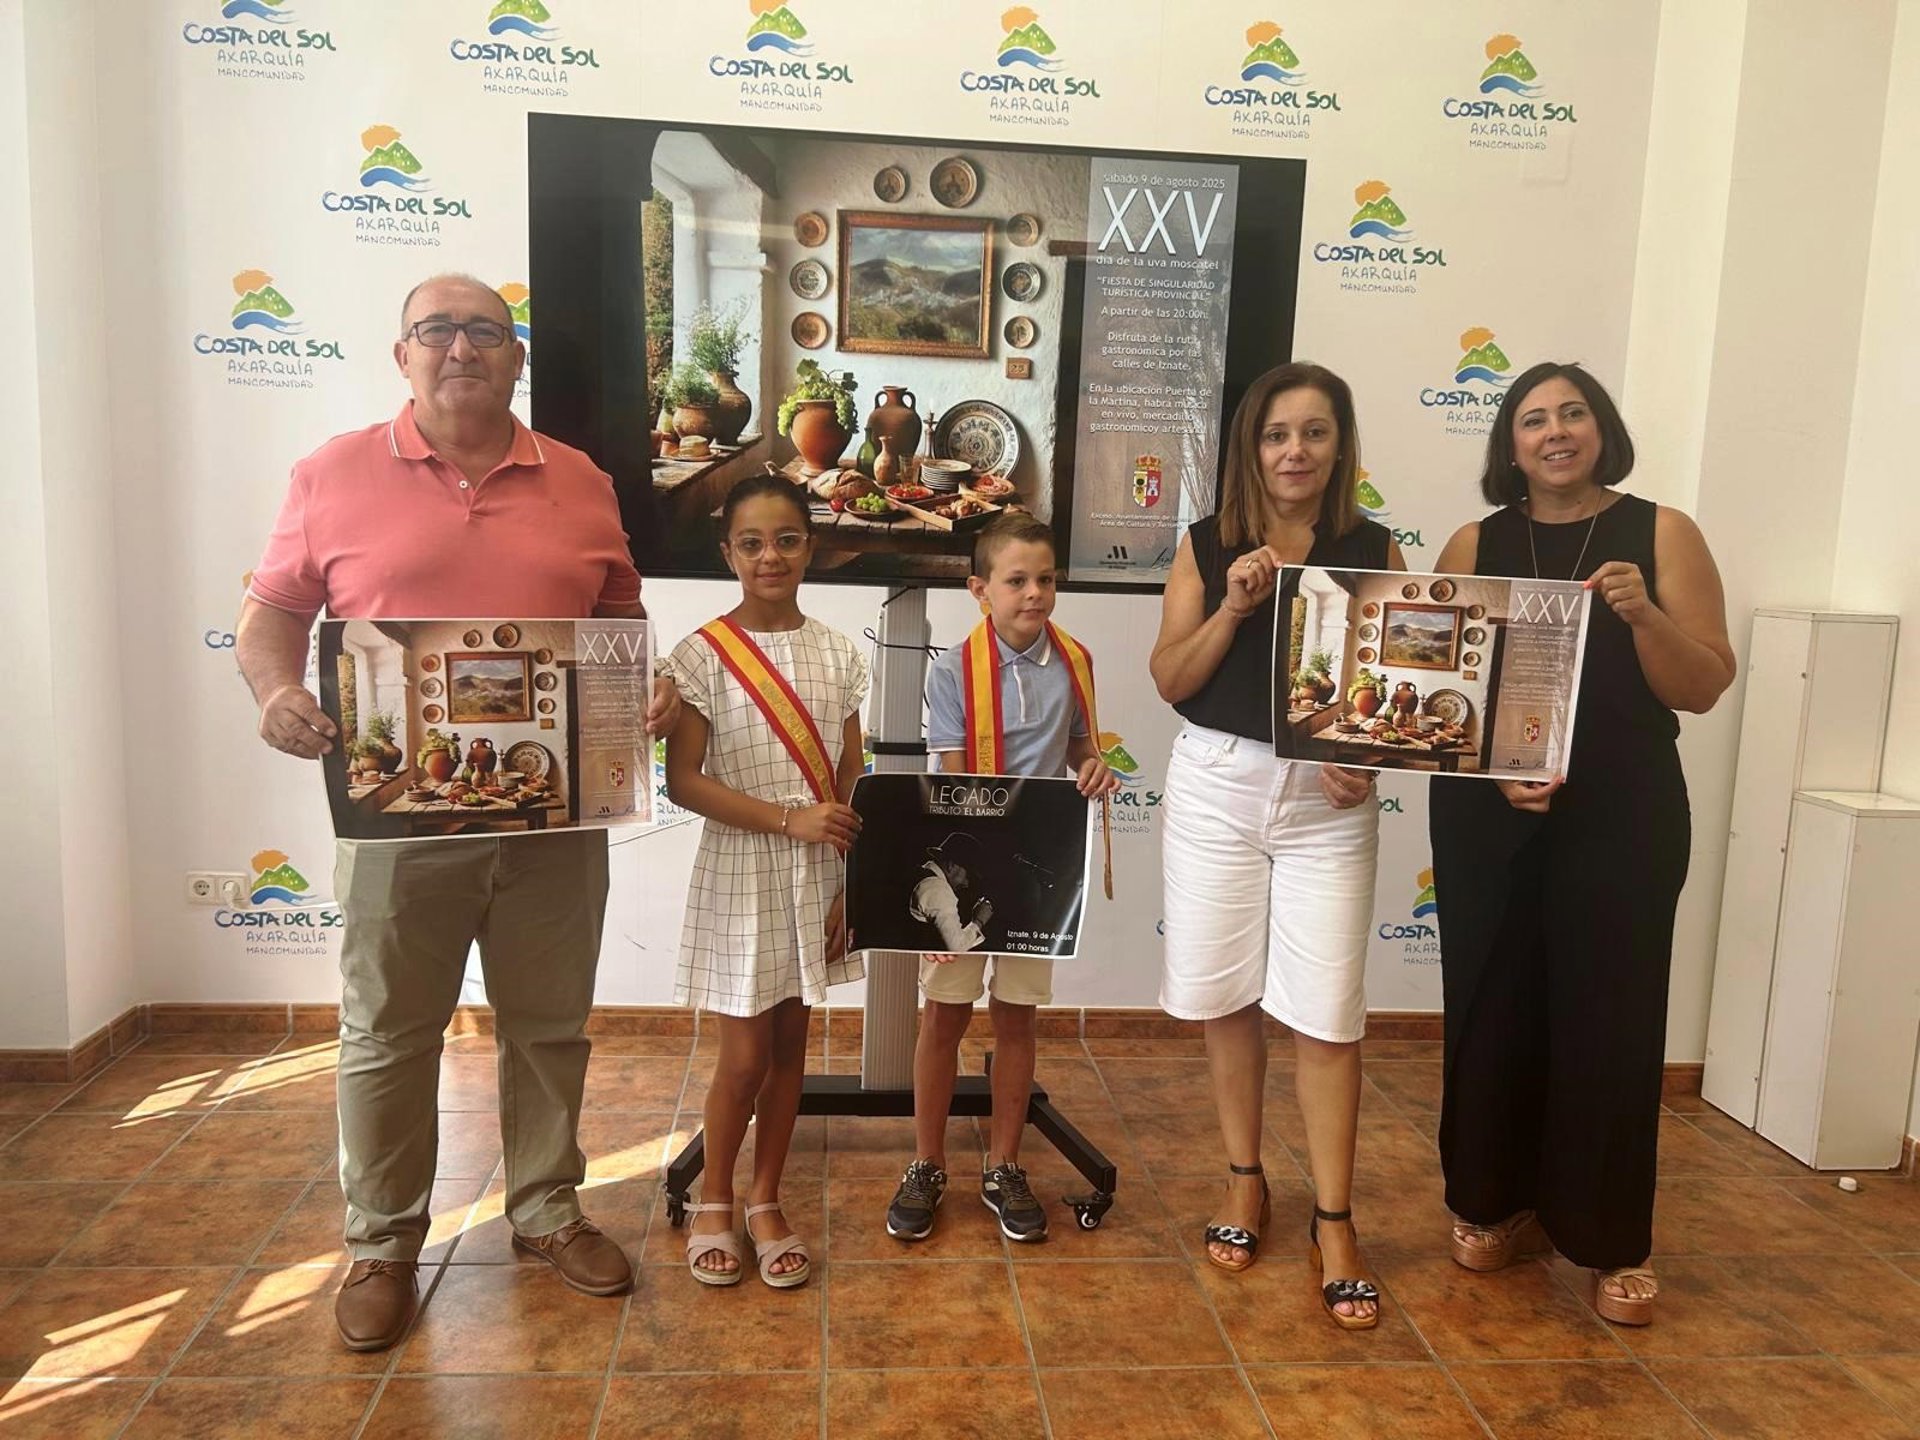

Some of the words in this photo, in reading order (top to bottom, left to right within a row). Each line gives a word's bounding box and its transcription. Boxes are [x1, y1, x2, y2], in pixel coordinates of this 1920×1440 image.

[183, 22, 253, 46] COSTA
[451, 38, 519, 63] COSTA
[709, 55, 776, 79] COSTA
[218, 68, 305, 81] MANCOMUNIDAD
[960, 71, 1025, 93] COSTA
[484, 84, 569, 97] MANCOMUNIDAD
[1204, 85, 1267, 108] COSTA
[740, 100, 822, 113] MANCOMUNIDAD
[1443, 98, 1504, 120] COSTA
[989, 115, 1070, 127] MANCOMUNIDAD
[1232, 127, 1311, 140] MANCOMUNIDAD
[1469, 140, 1547, 152] MANCOMUNIDAD
[1141, 175, 1147, 184] 9
[1150, 175, 1162, 185] de
[1166, 177, 1199, 188] agosto
[1202, 177, 1225, 188] 2025
[322, 191, 391, 213] COSTA
[1098, 187, 1224, 257] XXV
[356, 235, 440, 247] MANCOMUNIDAD
[1314, 242, 1375, 264] COSTA
[1116, 256, 1130, 266] de
[1133, 256, 1144, 266] la
[1147, 259, 1166, 267] uva
[1170, 258, 1219, 270] moscatel
[1134, 278, 1146, 287] DE
[1148, 279, 1215, 290] SINGULARIDAD
[1340, 283, 1416, 294] MANCOMUNIDAD
[1101, 306, 1109, 315] A
[1110, 307, 1137, 317] partir
[1141, 307, 1153, 317] de
[1157, 308, 1170, 318] las
[1108, 332, 1146, 343] Disfruta
[1150, 333, 1162, 343] de
[1164, 333, 1173, 343] la
[194, 334, 264, 356] COSTA
[1169, 349, 1184, 358] por
[1112, 358, 1140, 369] calles
[1143, 359, 1156, 369] de
[228, 377, 313, 389] MANCOMUNIDAD
[1089, 383, 1101, 393] En
[1104, 384, 1114, 393] la
[1199, 387, 1213, 397] de
[1089, 396, 1099, 405] la
[1420, 387, 1480, 408] COSTA
[1483, 392, 1504, 407] DE
[1101, 410, 1113, 419] en
[1447, 410, 1496, 424] AXARQ
[1513, 592, 1579, 624] XXV
[581, 633, 643, 664] XXV
[930, 785, 1009, 806] LEGADO
[929, 805, 961, 815] TRIBUTO
[215, 910, 280, 928] COSTA
[320, 911, 343, 927] SO
[1033, 931, 1038, 939] 9
[1379, 923, 1435, 940] COSTA
[246, 947, 327, 956] MANCOMUNIDAD
[1028, 944, 1049, 952] horas
